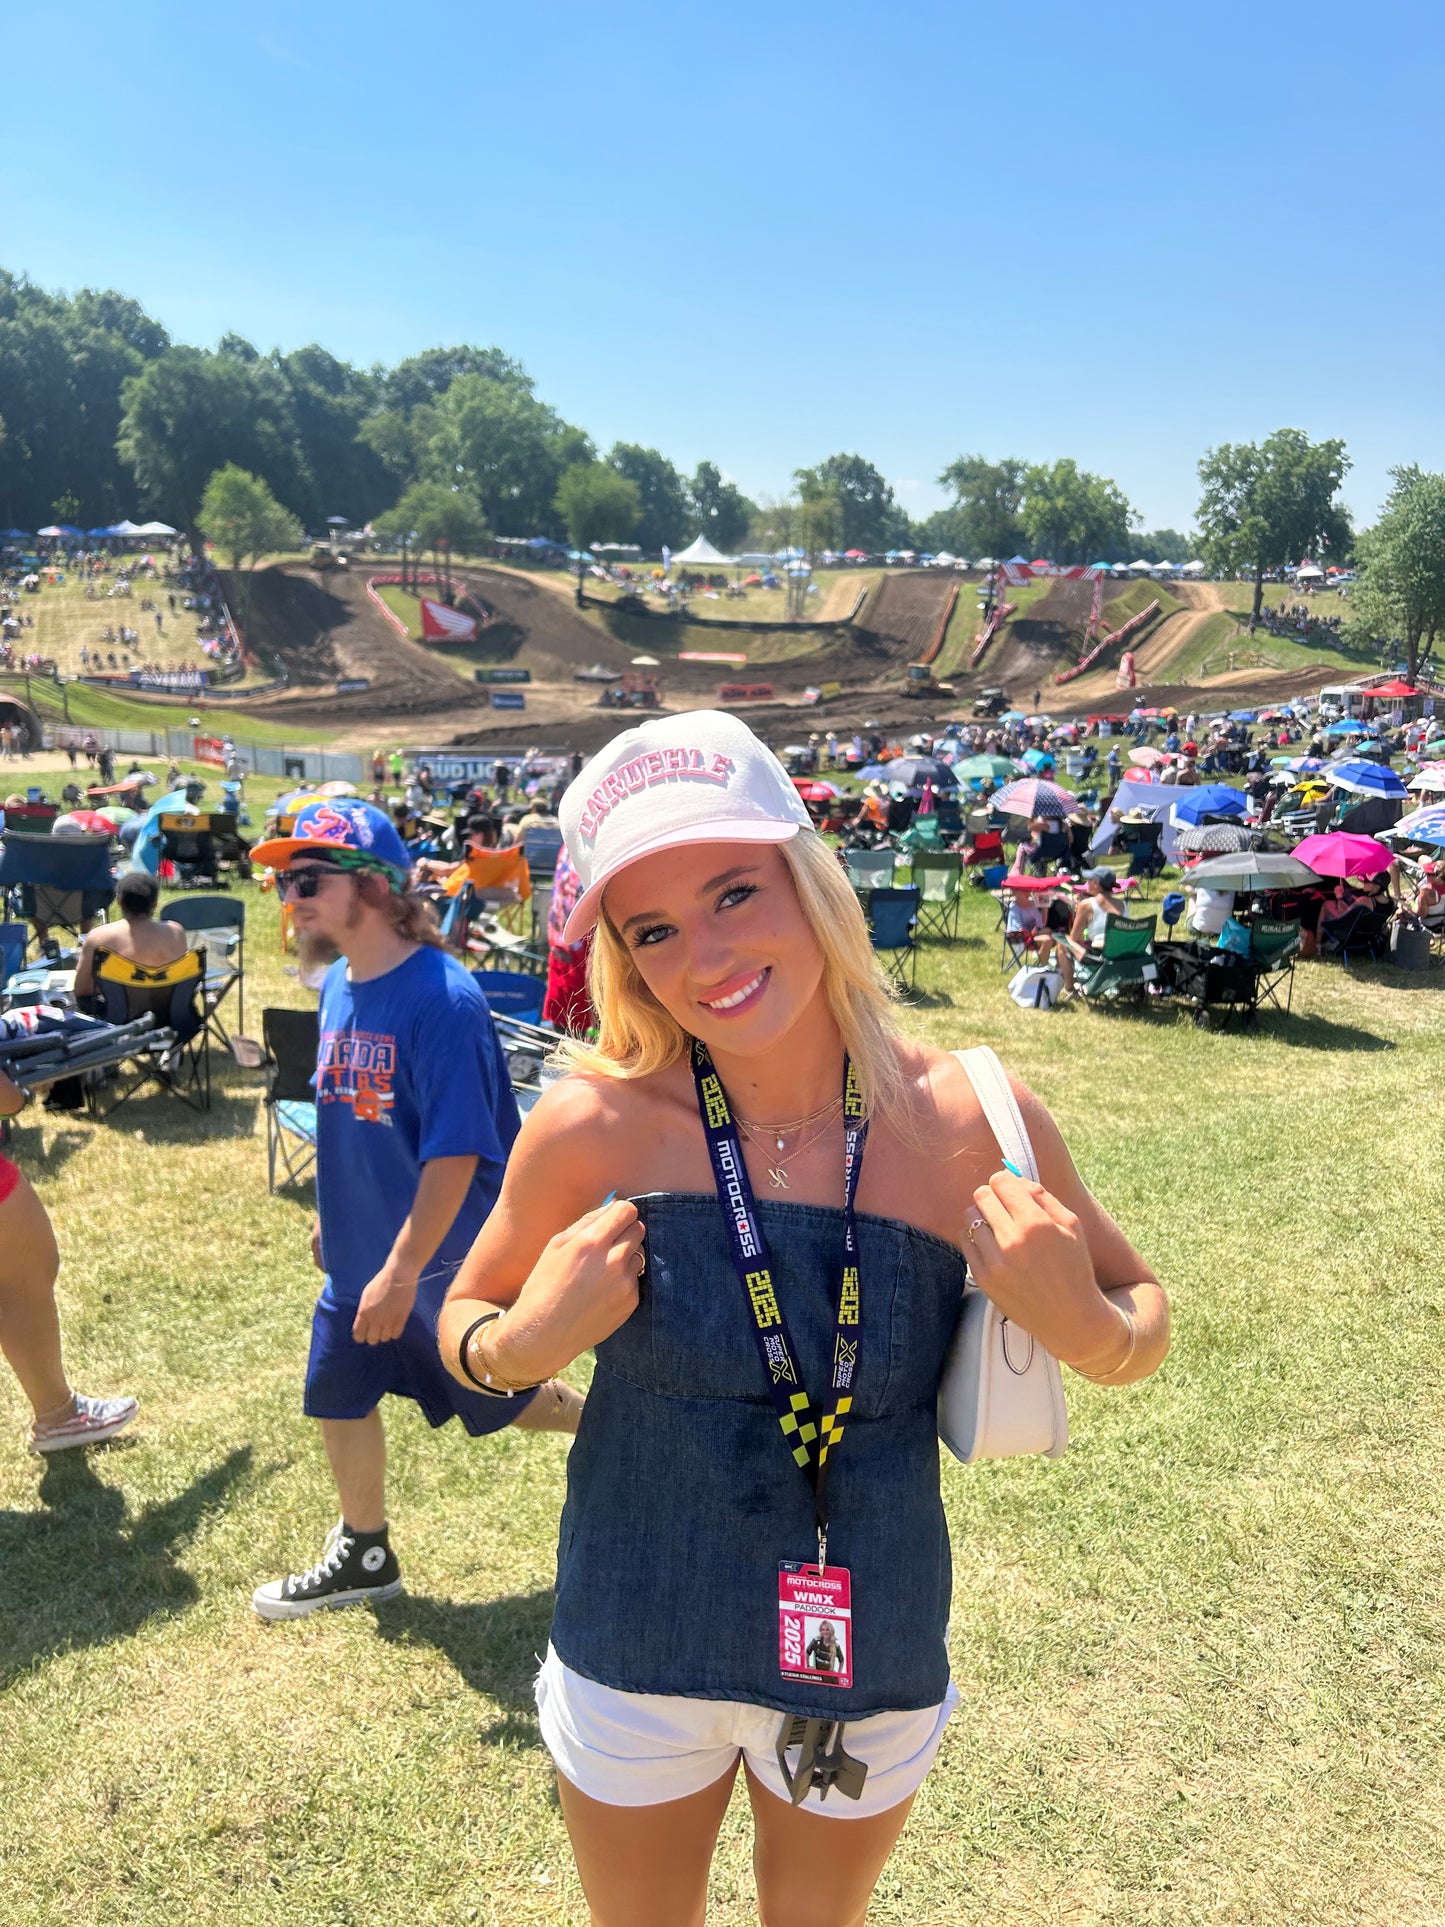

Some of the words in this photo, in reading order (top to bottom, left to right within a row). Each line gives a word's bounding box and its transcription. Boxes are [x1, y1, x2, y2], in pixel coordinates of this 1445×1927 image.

[701, 1073, 731, 1129] 2025
[717, 1139, 757, 1258] MOTOCROSS
[745, 1269, 782, 1329] 2025
[838, 1267, 859, 1325] 2025
[768, 1337, 780, 1362] MOTO
[774, 1334, 786, 1362] SUPER
[841, 1361, 849, 1386] MOTO
[787, 1578, 842, 1590] MOTOCROSS
[793, 1591, 834, 1606] WMX
[794, 1603, 837, 1615] PADDOCK
[784, 1614, 801, 1667] 2025
